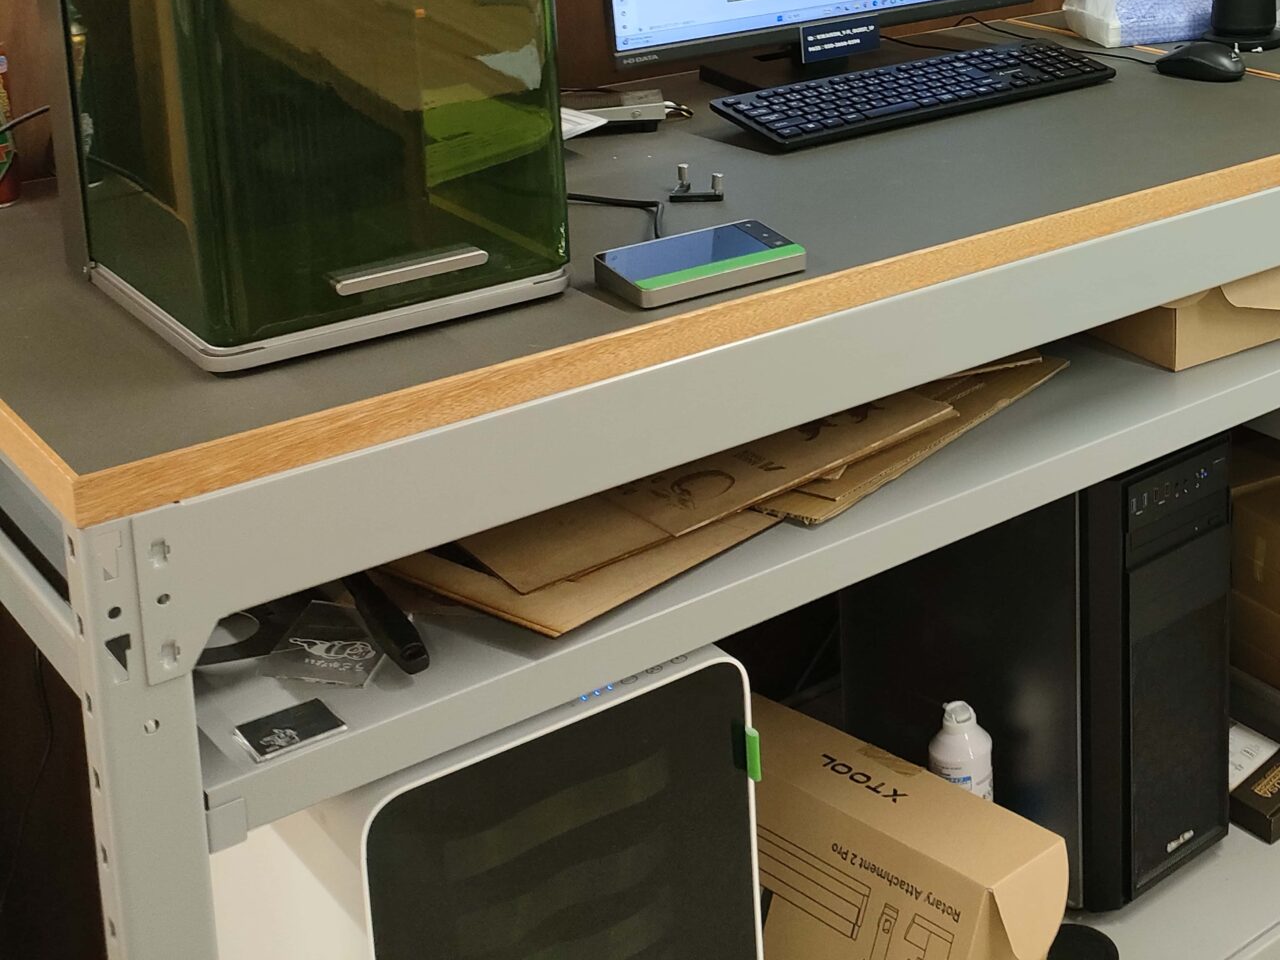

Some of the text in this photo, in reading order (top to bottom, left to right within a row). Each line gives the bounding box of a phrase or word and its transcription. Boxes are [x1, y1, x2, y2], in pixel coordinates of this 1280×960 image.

[821, 753, 909, 804] XTOOL
[831, 842, 961, 924] Rotary Attachment 2 Pro
